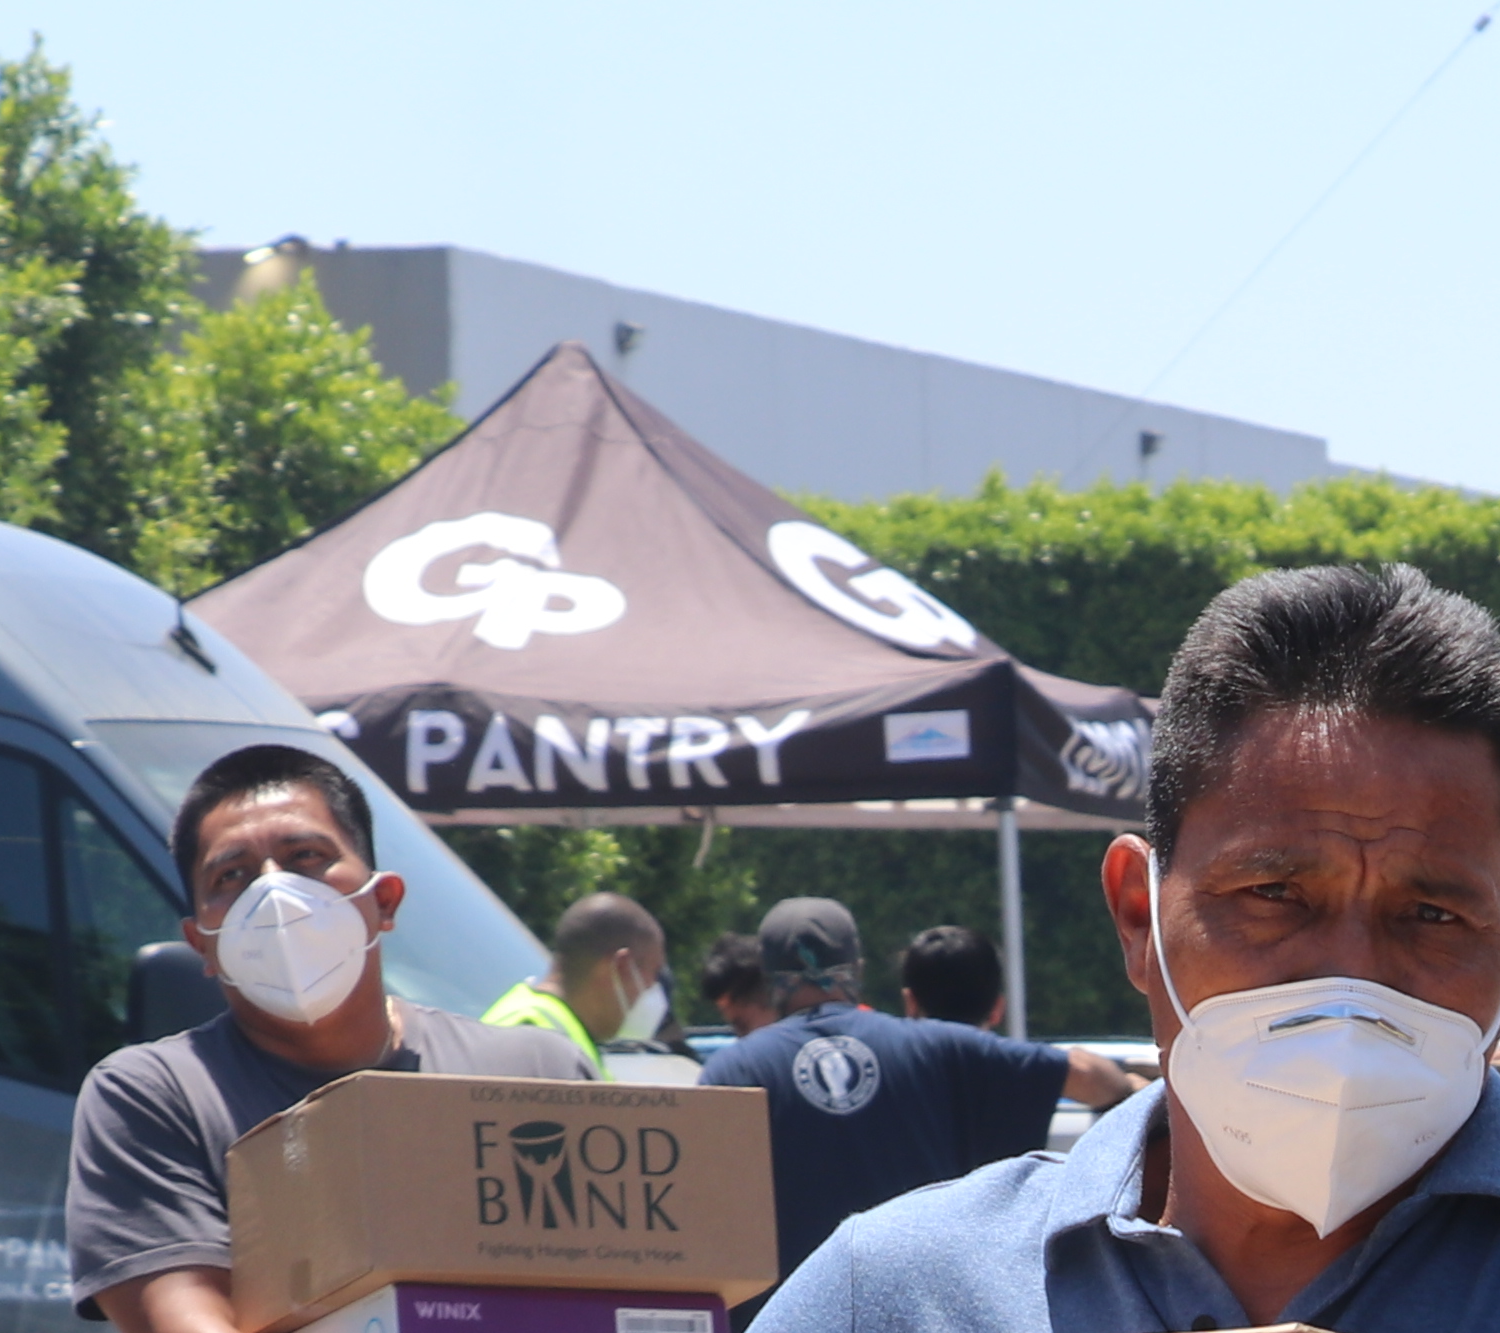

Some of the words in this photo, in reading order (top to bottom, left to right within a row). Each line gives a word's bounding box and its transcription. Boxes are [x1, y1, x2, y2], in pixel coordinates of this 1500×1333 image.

[406, 707, 810, 796] PANTRY
[510, 1088, 584, 1105] ANGELES
[414, 1301, 482, 1322] WINIX
